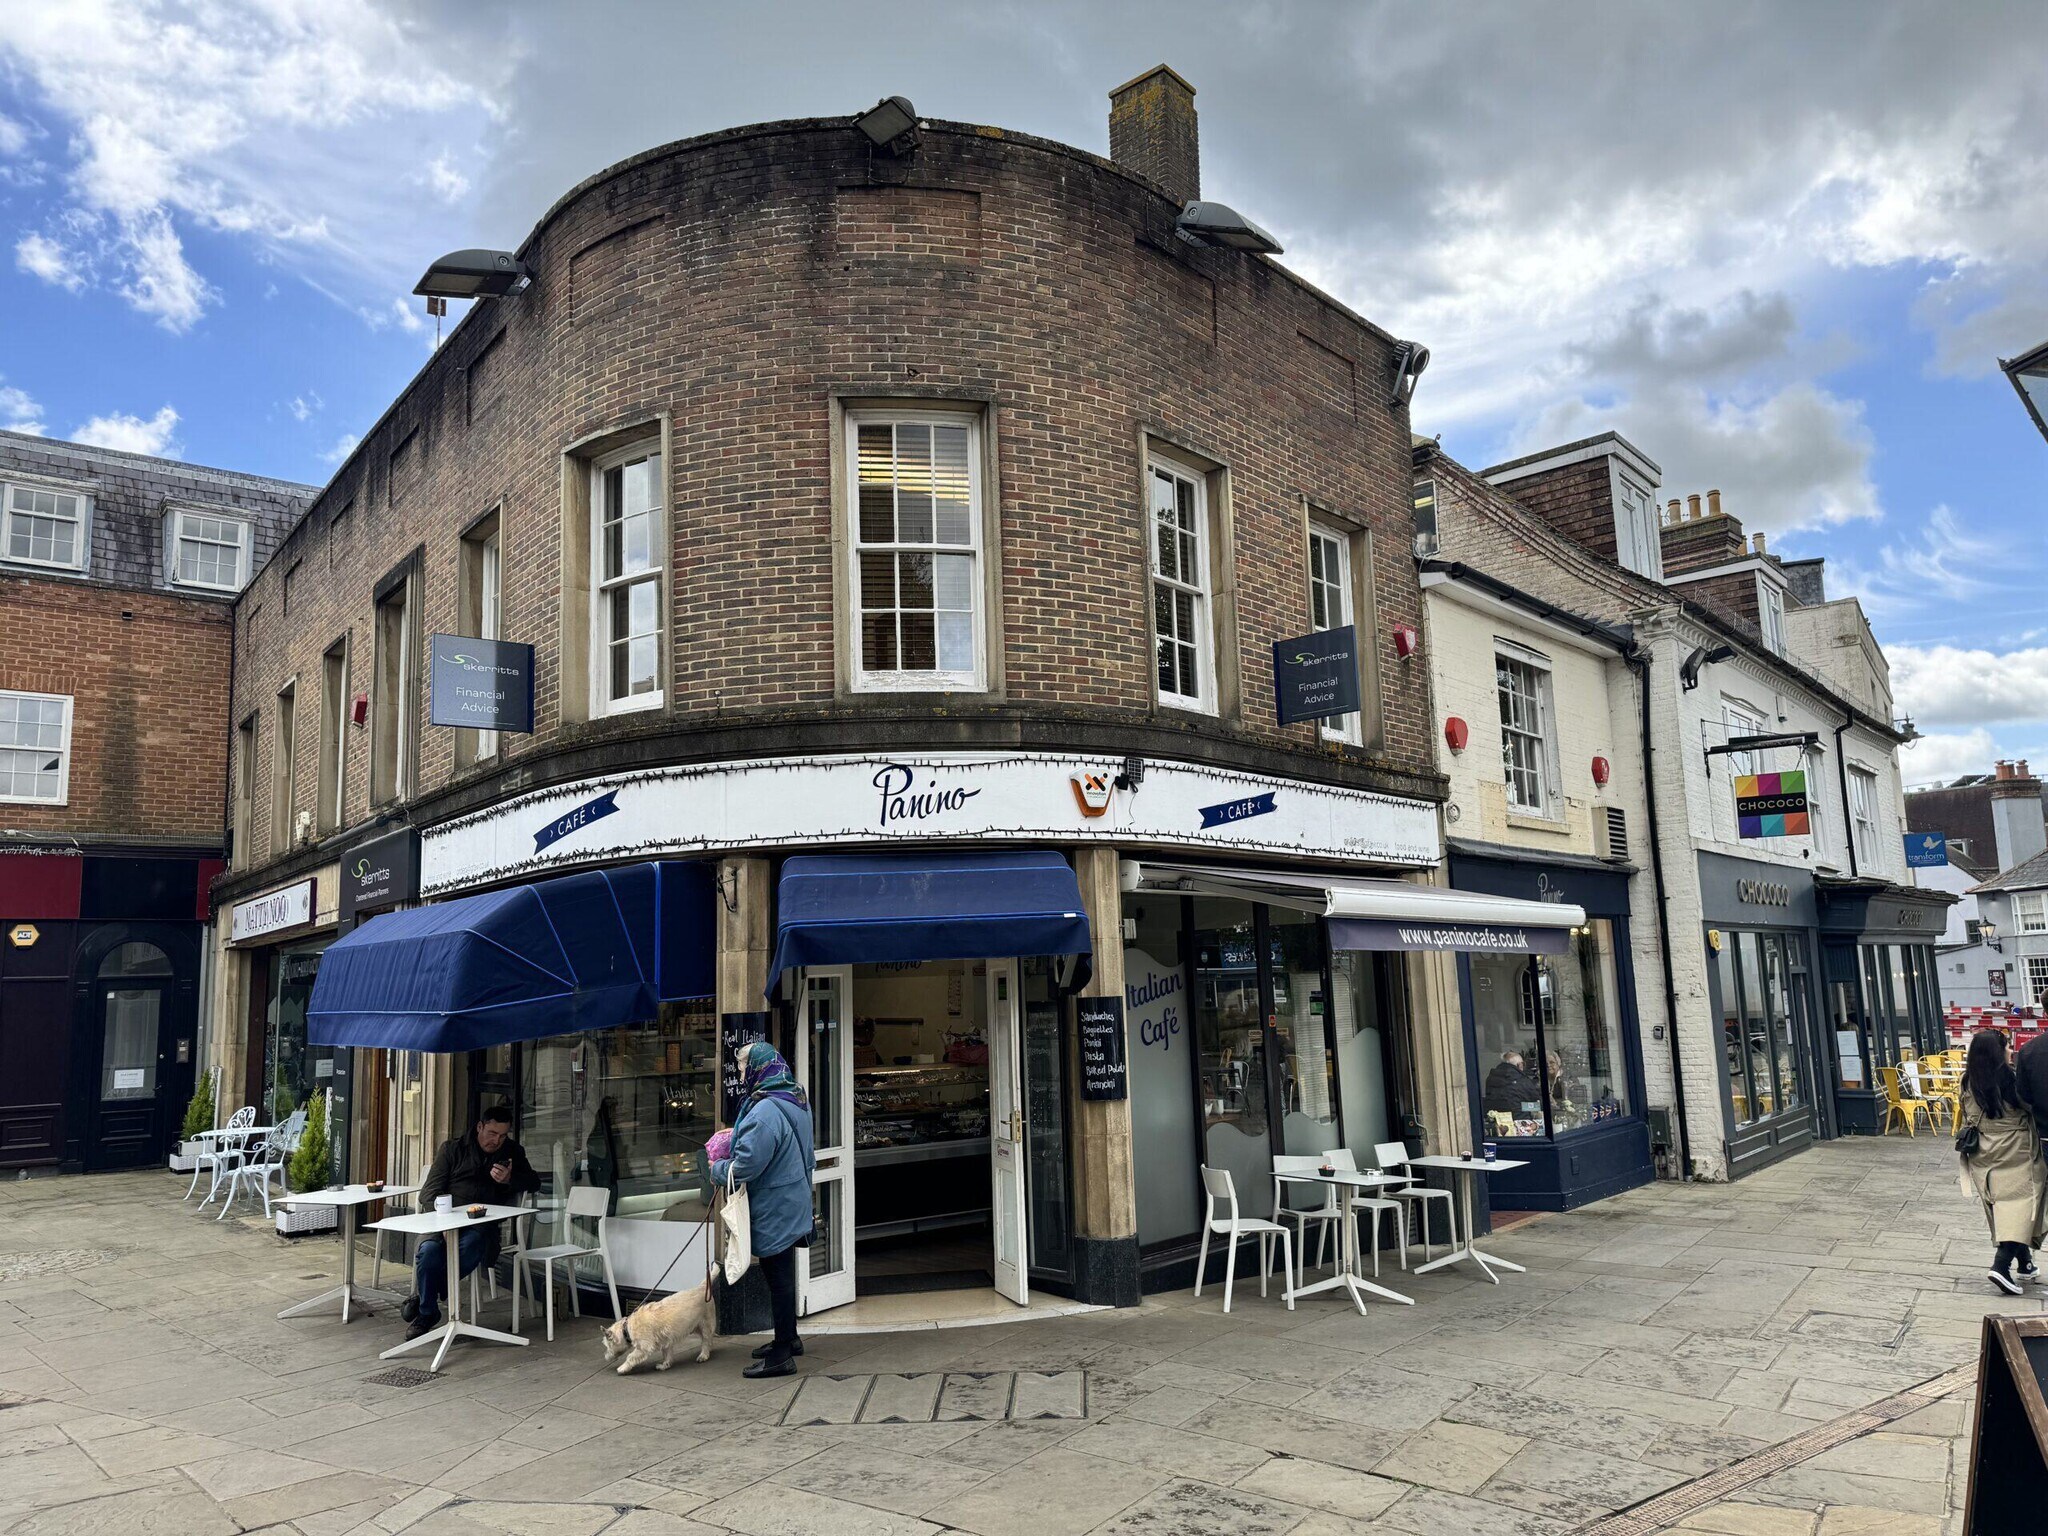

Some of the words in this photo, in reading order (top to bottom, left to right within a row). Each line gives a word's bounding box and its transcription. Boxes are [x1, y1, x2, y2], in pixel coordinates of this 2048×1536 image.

[1302, 652, 1349, 667] skerritts
[463, 663, 520, 676] skerritts
[1298, 676, 1339, 692] Financial
[455, 686, 505, 700] Financial
[1304, 692, 1335, 705] Advice
[460, 702, 500, 714] Advice
[872, 764, 982, 827] Panino
[1228, 799, 1254, 819] CAFÉ
[1738, 797, 1805, 811] CHOCOCO
[557, 806, 586, 837] CAFÉ
[1908, 850, 1945, 861] transform
[361, 867, 390, 887] skerritts
[1739, 878, 1789, 906] CHOCOCO
[1399, 926, 1529, 949] www.paninocafe.co.uk
[1125, 972, 1183, 1011] Italian
[1081, 1010, 1115, 1022] Sandwiches
[1083, 1025, 1114, 1037] Baguettes
[1140, 1006, 1181, 1051] Café
[724, 1029, 738, 1047] Real
[742, 1029, 766, 1045] Italian
[1084, 1051, 1105, 1062] Pasta
